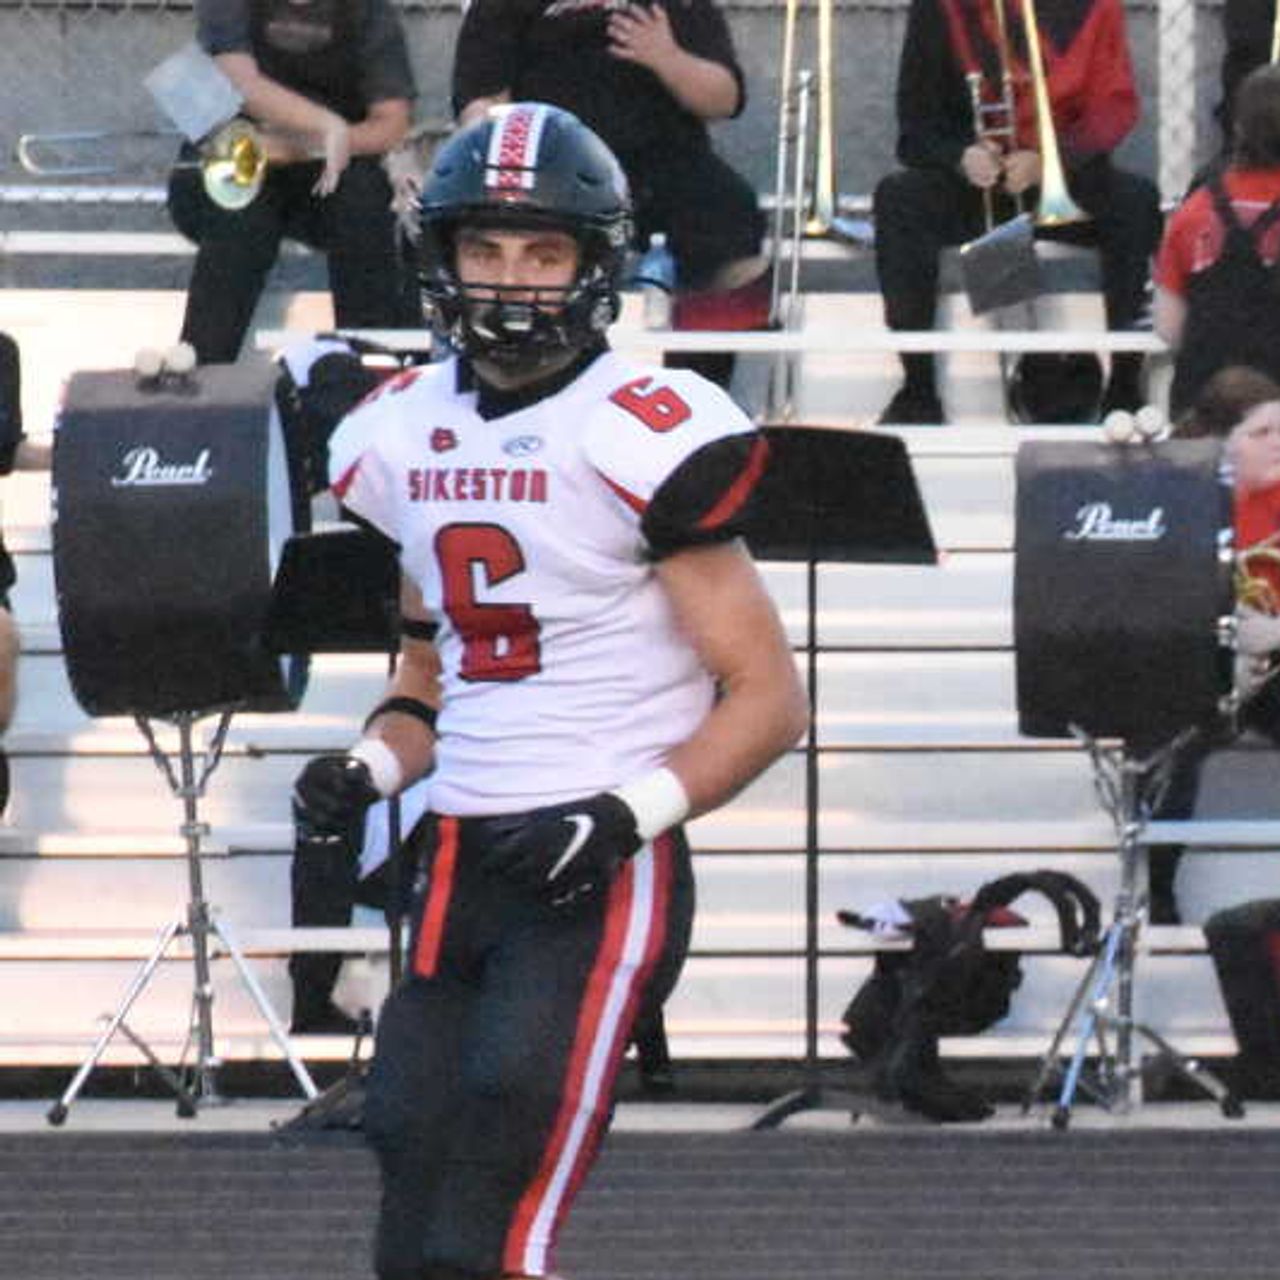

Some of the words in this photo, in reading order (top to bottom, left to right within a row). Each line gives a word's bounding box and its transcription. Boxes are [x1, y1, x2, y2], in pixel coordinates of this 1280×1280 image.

[608, 376, 693, 434] 6
[111, 447, 212, 487] Pearl
[407, 467, 547, 502] SIKESTON
[432, 521, 542, 683] 6
